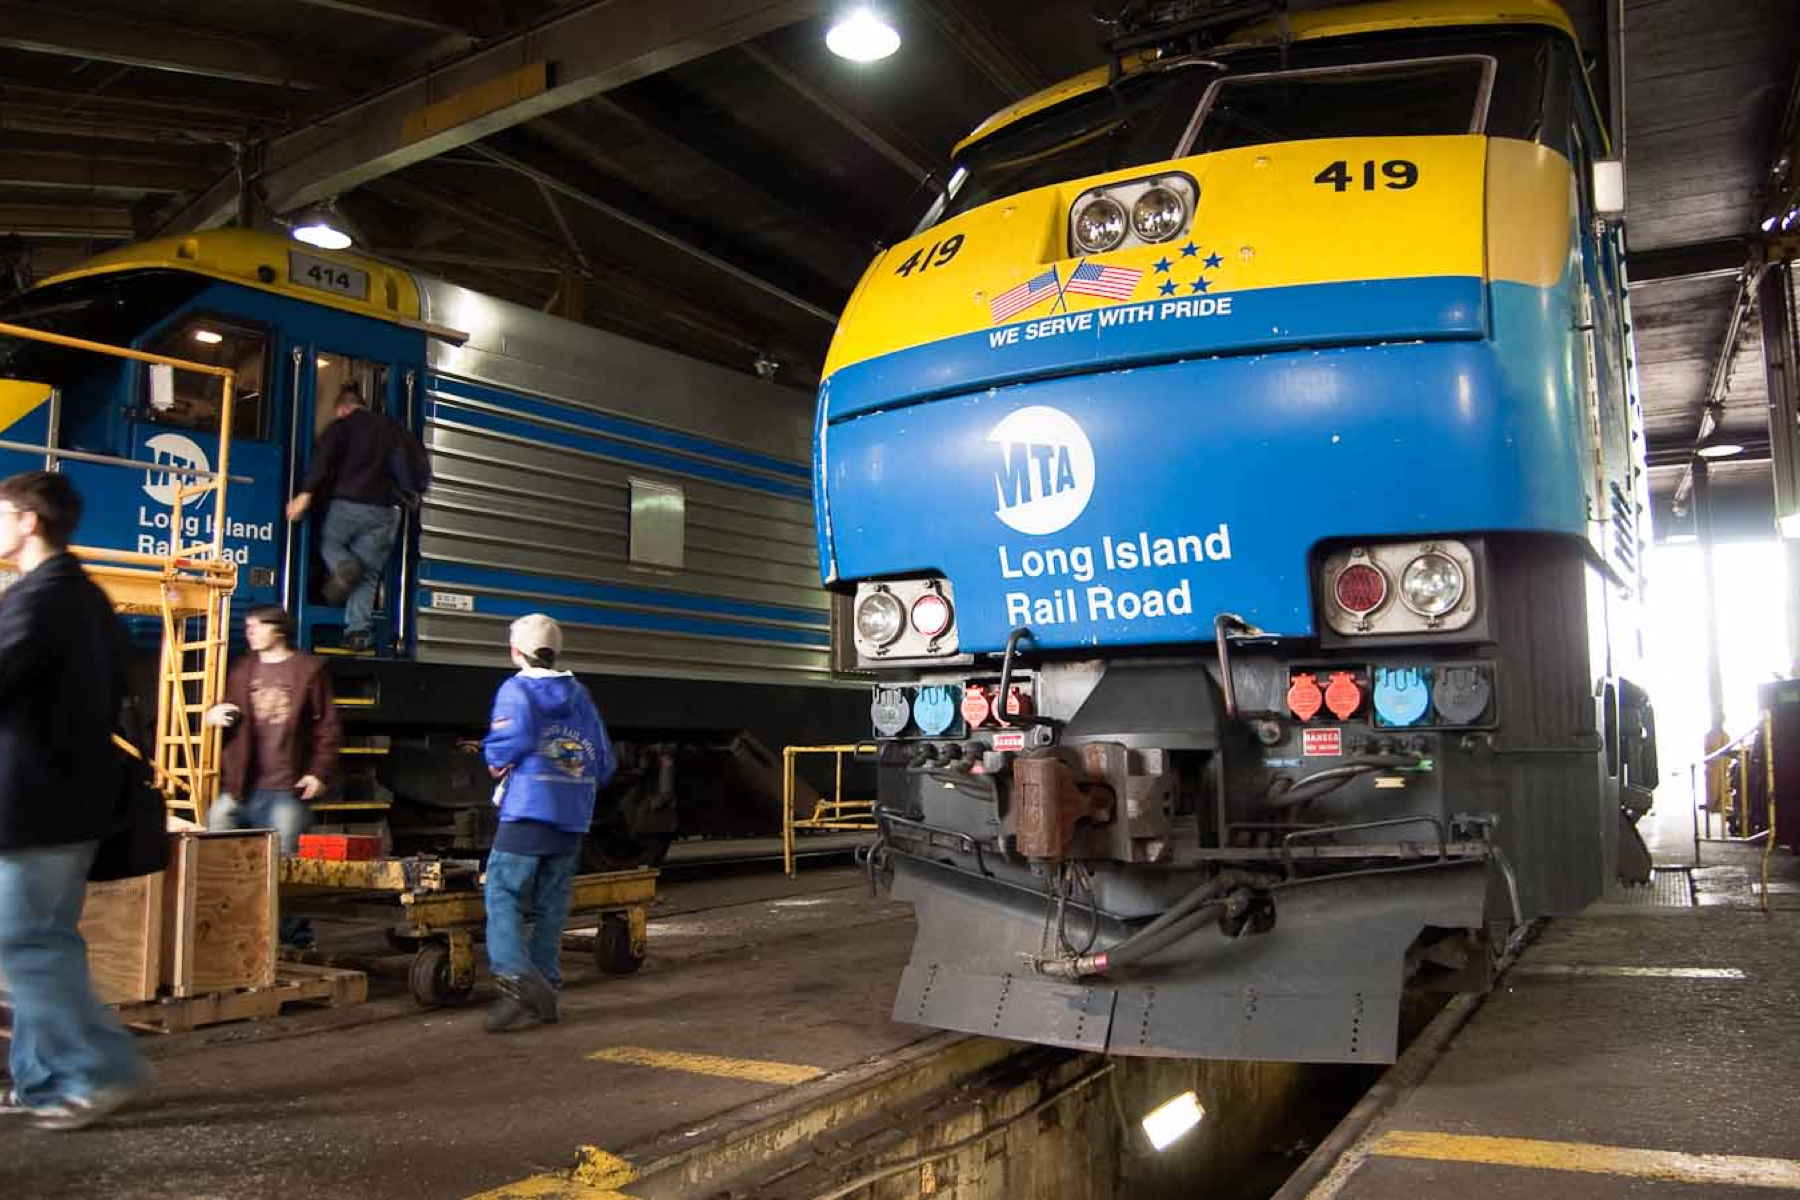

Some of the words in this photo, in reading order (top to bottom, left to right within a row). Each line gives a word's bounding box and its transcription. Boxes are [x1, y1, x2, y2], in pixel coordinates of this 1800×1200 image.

[1314, 160, 1418, 192] 419
[307, 264, 350, 289] 414
[894, 233, 965, 278] 419
[989, 327, 1020, 349] WE
[1025, 312, 1092, 341] SERVE
[1098, 304, 1154, 328] WITH
[1160, 297, 1233, 320] PRIDE
[989, 440, 1076, 513] MTA
[139, 505, 199, 536] Log
[206, 514, 273, 541] Iland
[999, 545, 1095, 582] Long
[1103, 523, 1232, 571] Island
[1005, 588, 1078, 626] Rail
[1086, 579, 1193, 622] Road
